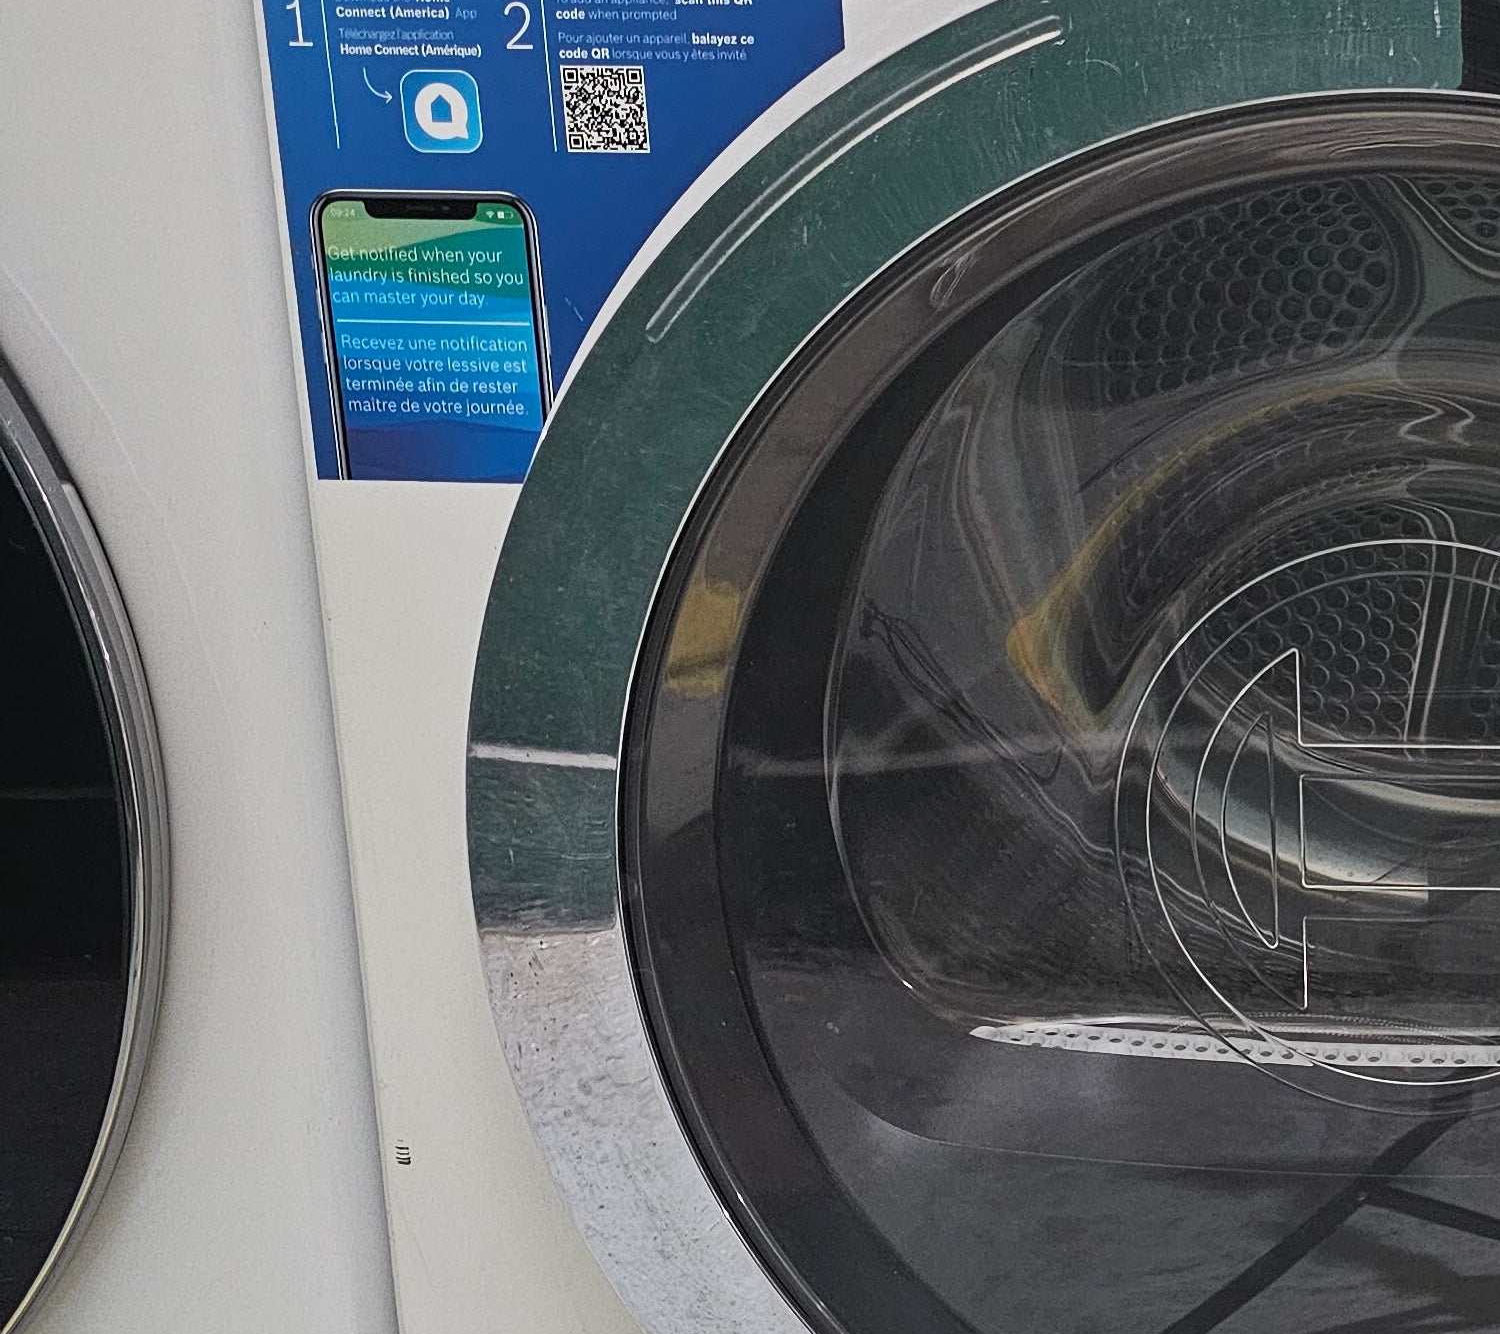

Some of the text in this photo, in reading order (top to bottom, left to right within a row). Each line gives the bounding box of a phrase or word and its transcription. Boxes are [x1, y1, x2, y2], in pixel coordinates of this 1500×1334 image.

[336, 6, 387, 18] Connect
[390, 6, 450, 20] (America)
[556, 8, 677, 23] code when prompted
[503, 1, 534, 50] 2
[691, 32, 755, 47] balayez ce
[340, 43, 482, 58] Home Connect (Amérique)
[559, 48, 610, 60] code QR
